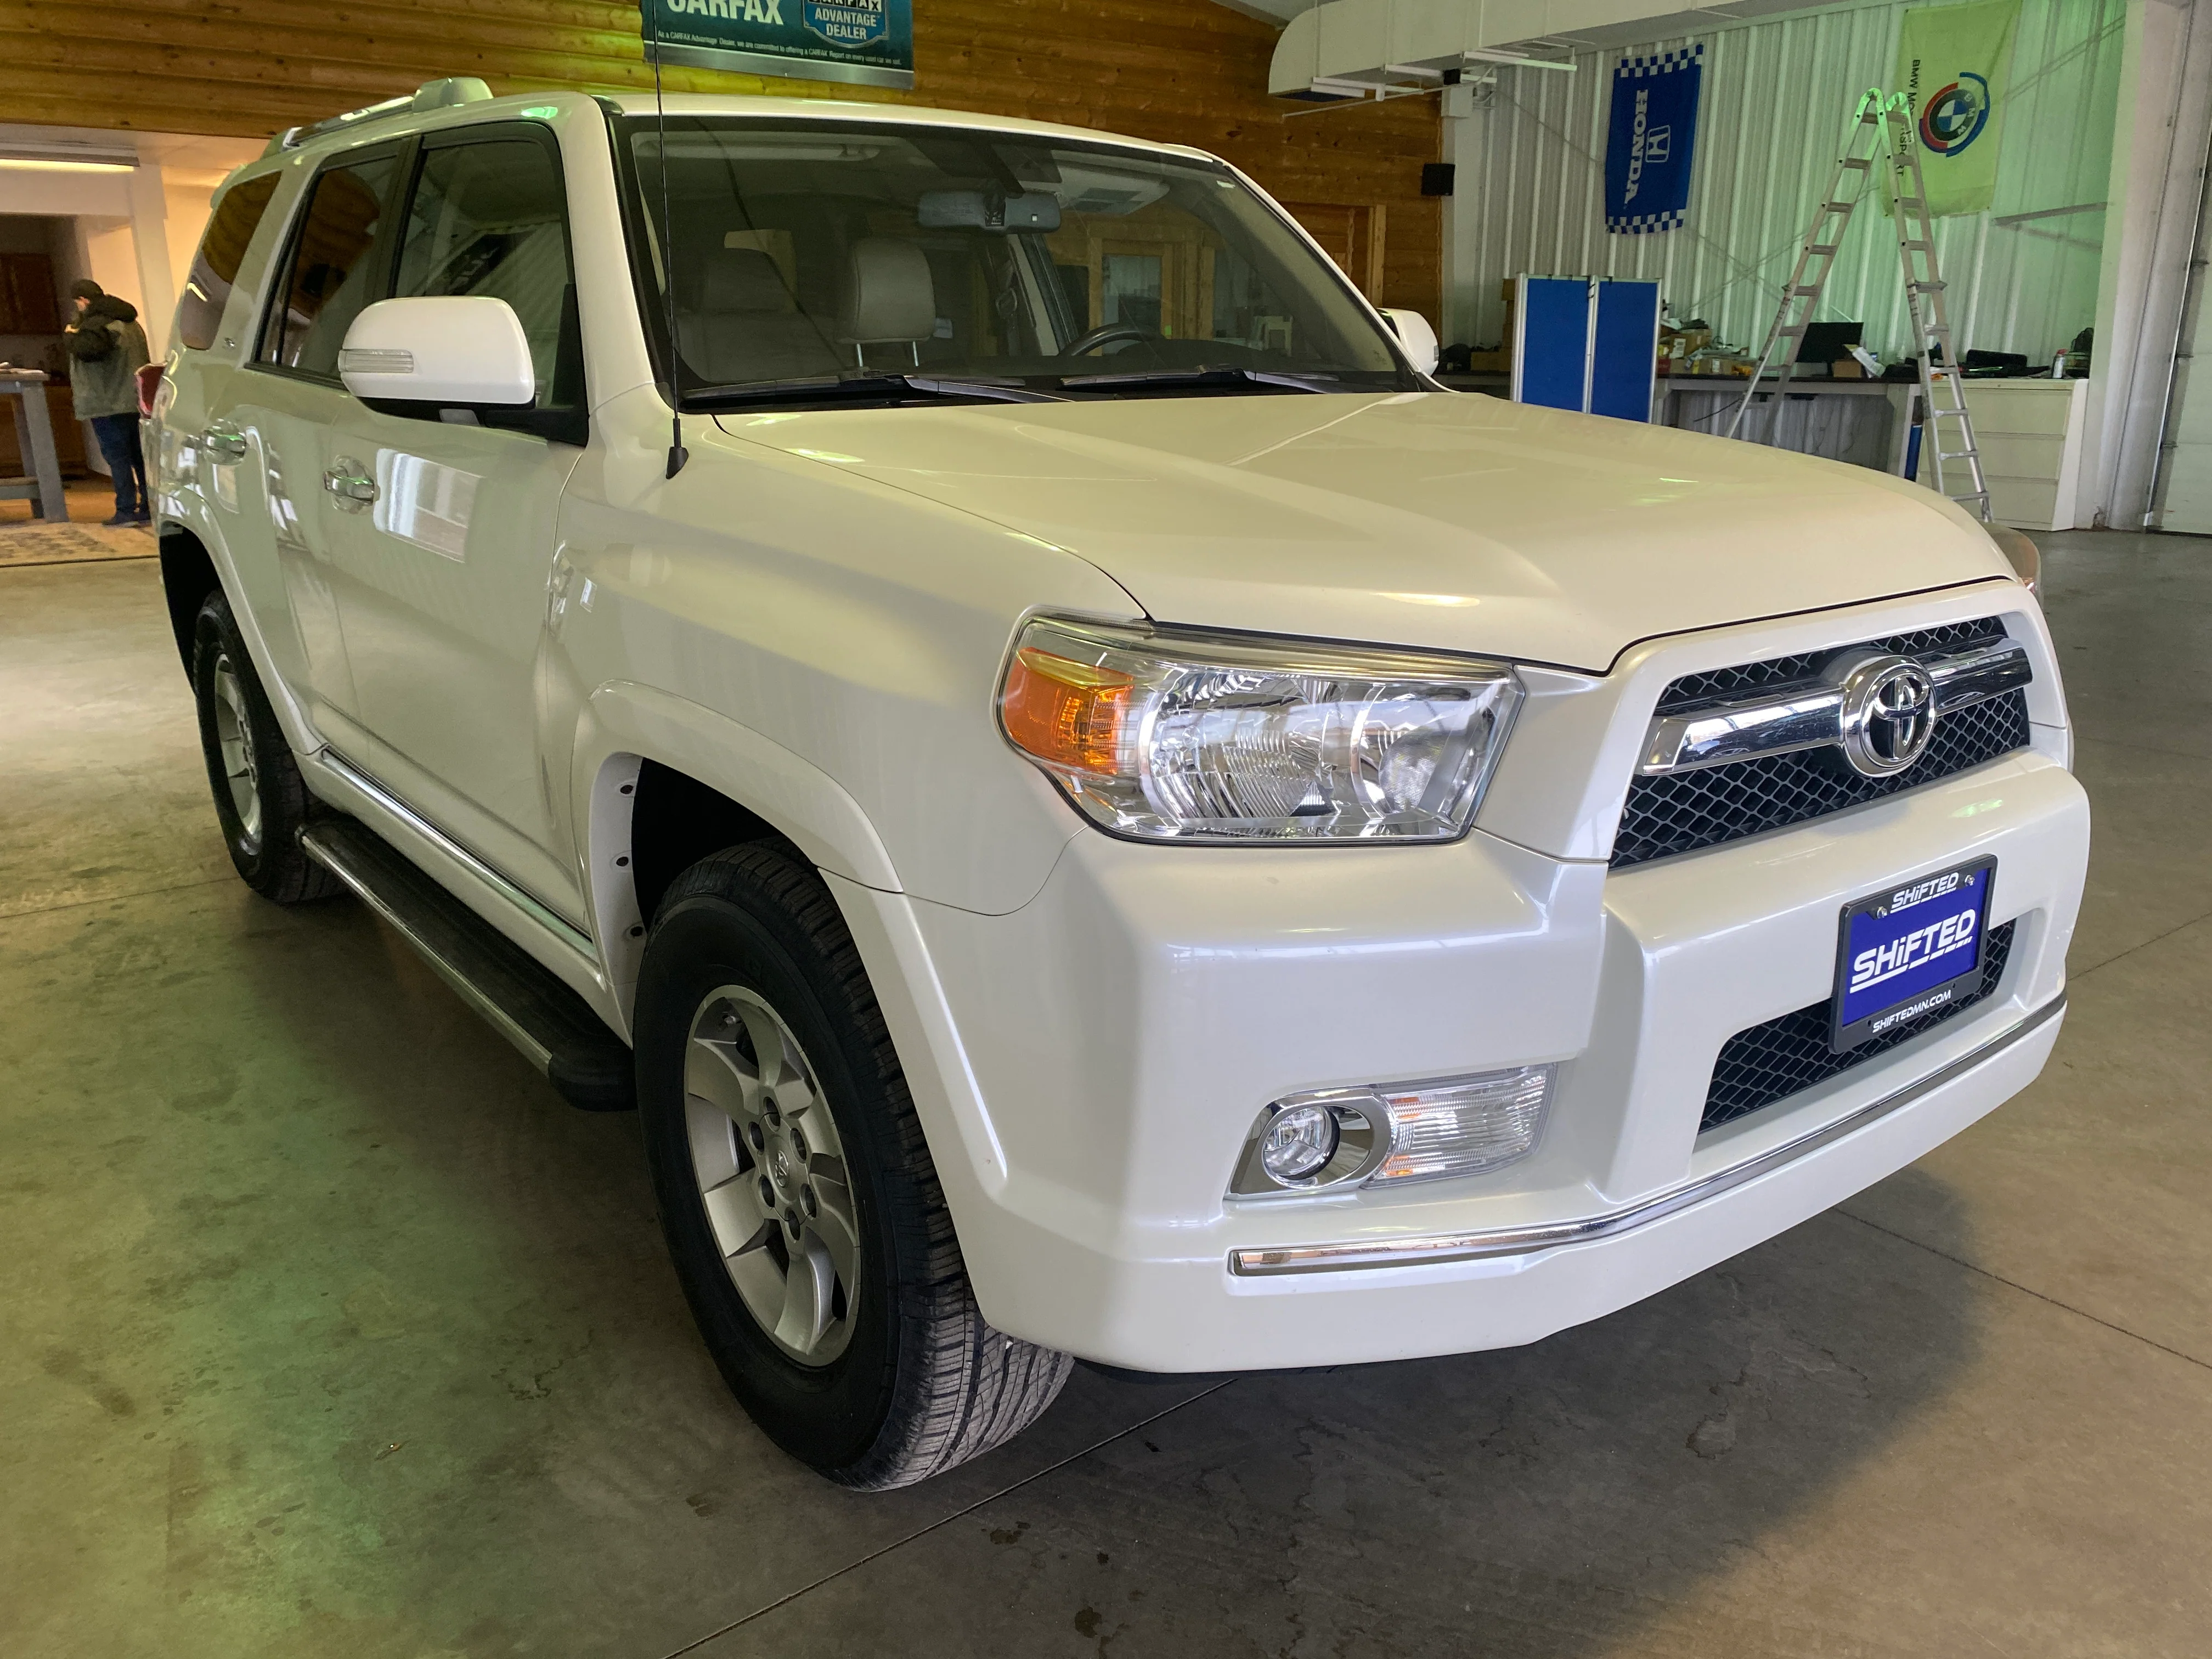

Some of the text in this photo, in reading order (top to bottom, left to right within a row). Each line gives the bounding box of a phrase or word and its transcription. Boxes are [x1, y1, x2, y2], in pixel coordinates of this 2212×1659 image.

[812, 0, 879, 11] FAX
[815, 7, 877, 27] ADVANTAGE
[826, 23, 867, 40] DEALER
[1909, 59, 1920, 88] BMW
[1624, 89, 1648, 205] HONDA
[1872, 989, 1951, 1034] SHIFTEDMN.COM
